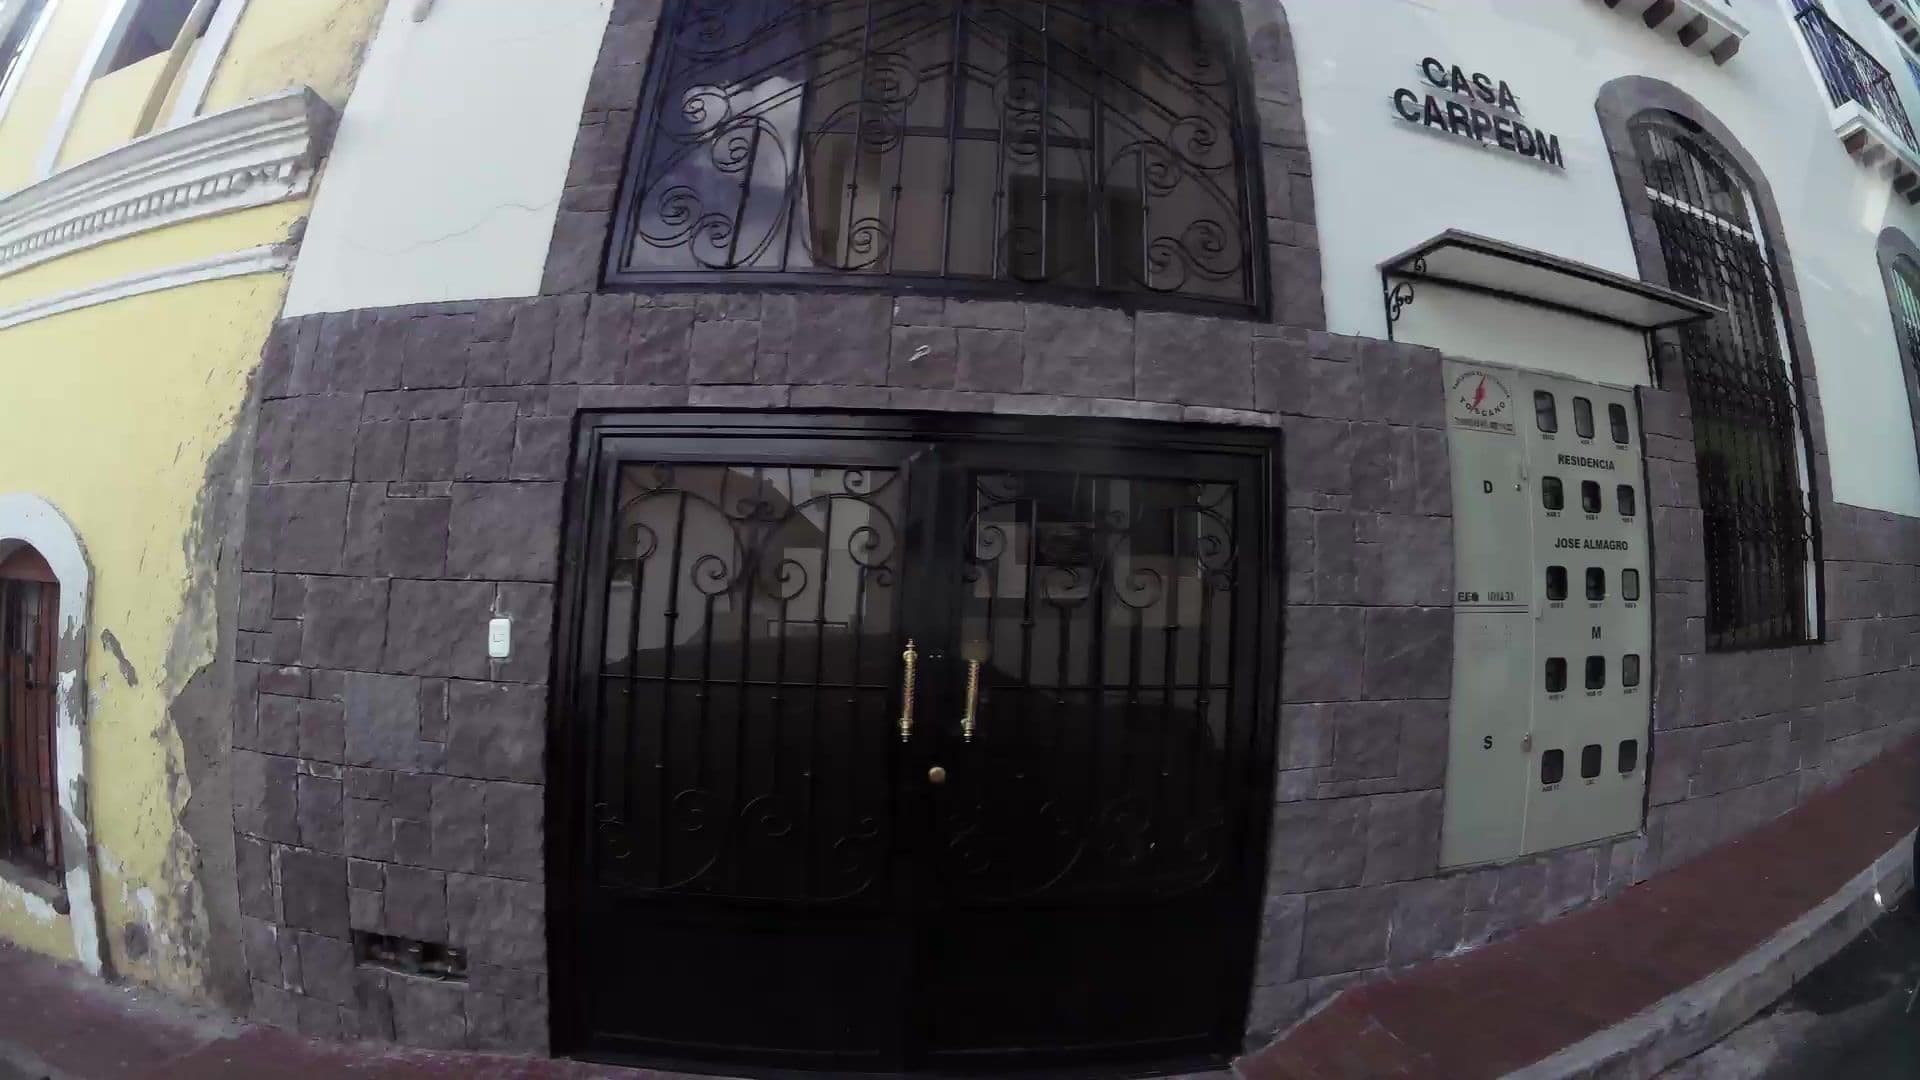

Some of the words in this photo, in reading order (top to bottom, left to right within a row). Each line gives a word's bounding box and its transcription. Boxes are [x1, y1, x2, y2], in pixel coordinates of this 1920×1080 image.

[1421, 57, 1524, 117] CASA
[1393, 88, 1566, 169] CARPEDM
[1460, 396, 1505, 416] TOSCANO
[1557, 454, 1615, 470] RESIDENCIA
[1483, 480, 1493, 494] D
[1554, 537, 1580, 549] JOSE
[1583, 539, 1628, 551] ALMAGRO
[1592, 626, 1601, 640] M
[1483, 735, 1493, 749] S
